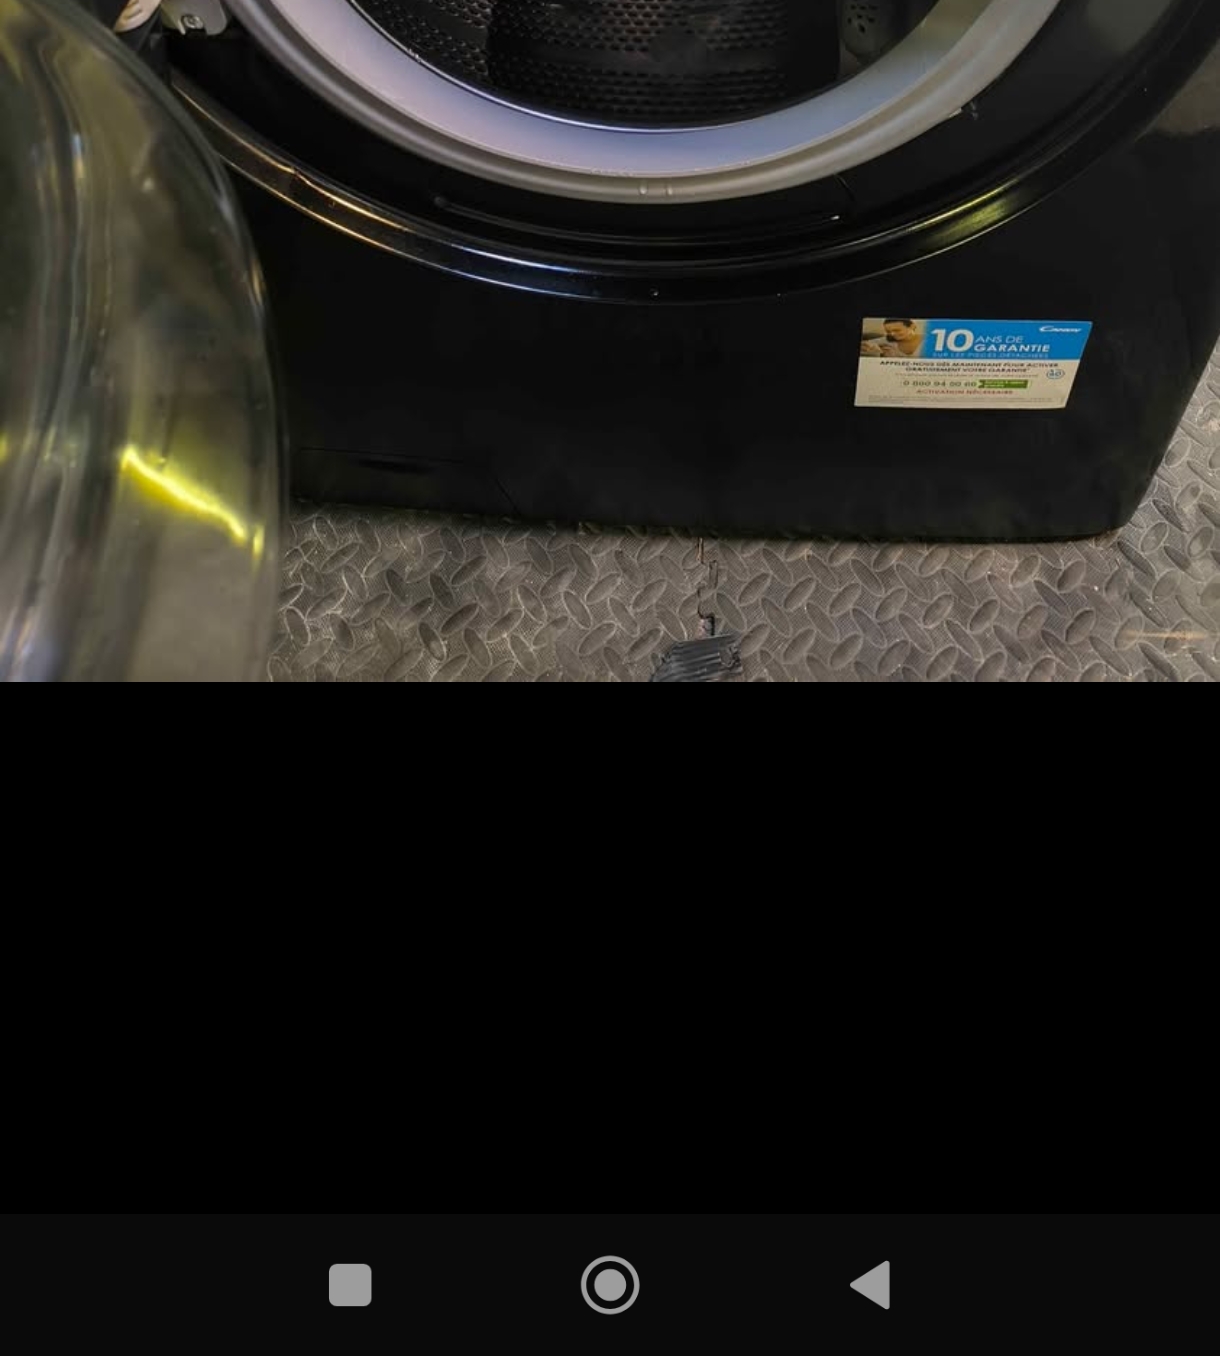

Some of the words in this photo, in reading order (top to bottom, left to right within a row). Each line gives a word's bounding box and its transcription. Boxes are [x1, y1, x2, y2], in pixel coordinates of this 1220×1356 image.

[931, 328, 975, 353] 10
[974, 335, 1001, 344] ANS
[1006, 336, 1024, 344] DE
[974, 343, 1051, 353] GARANTIE
